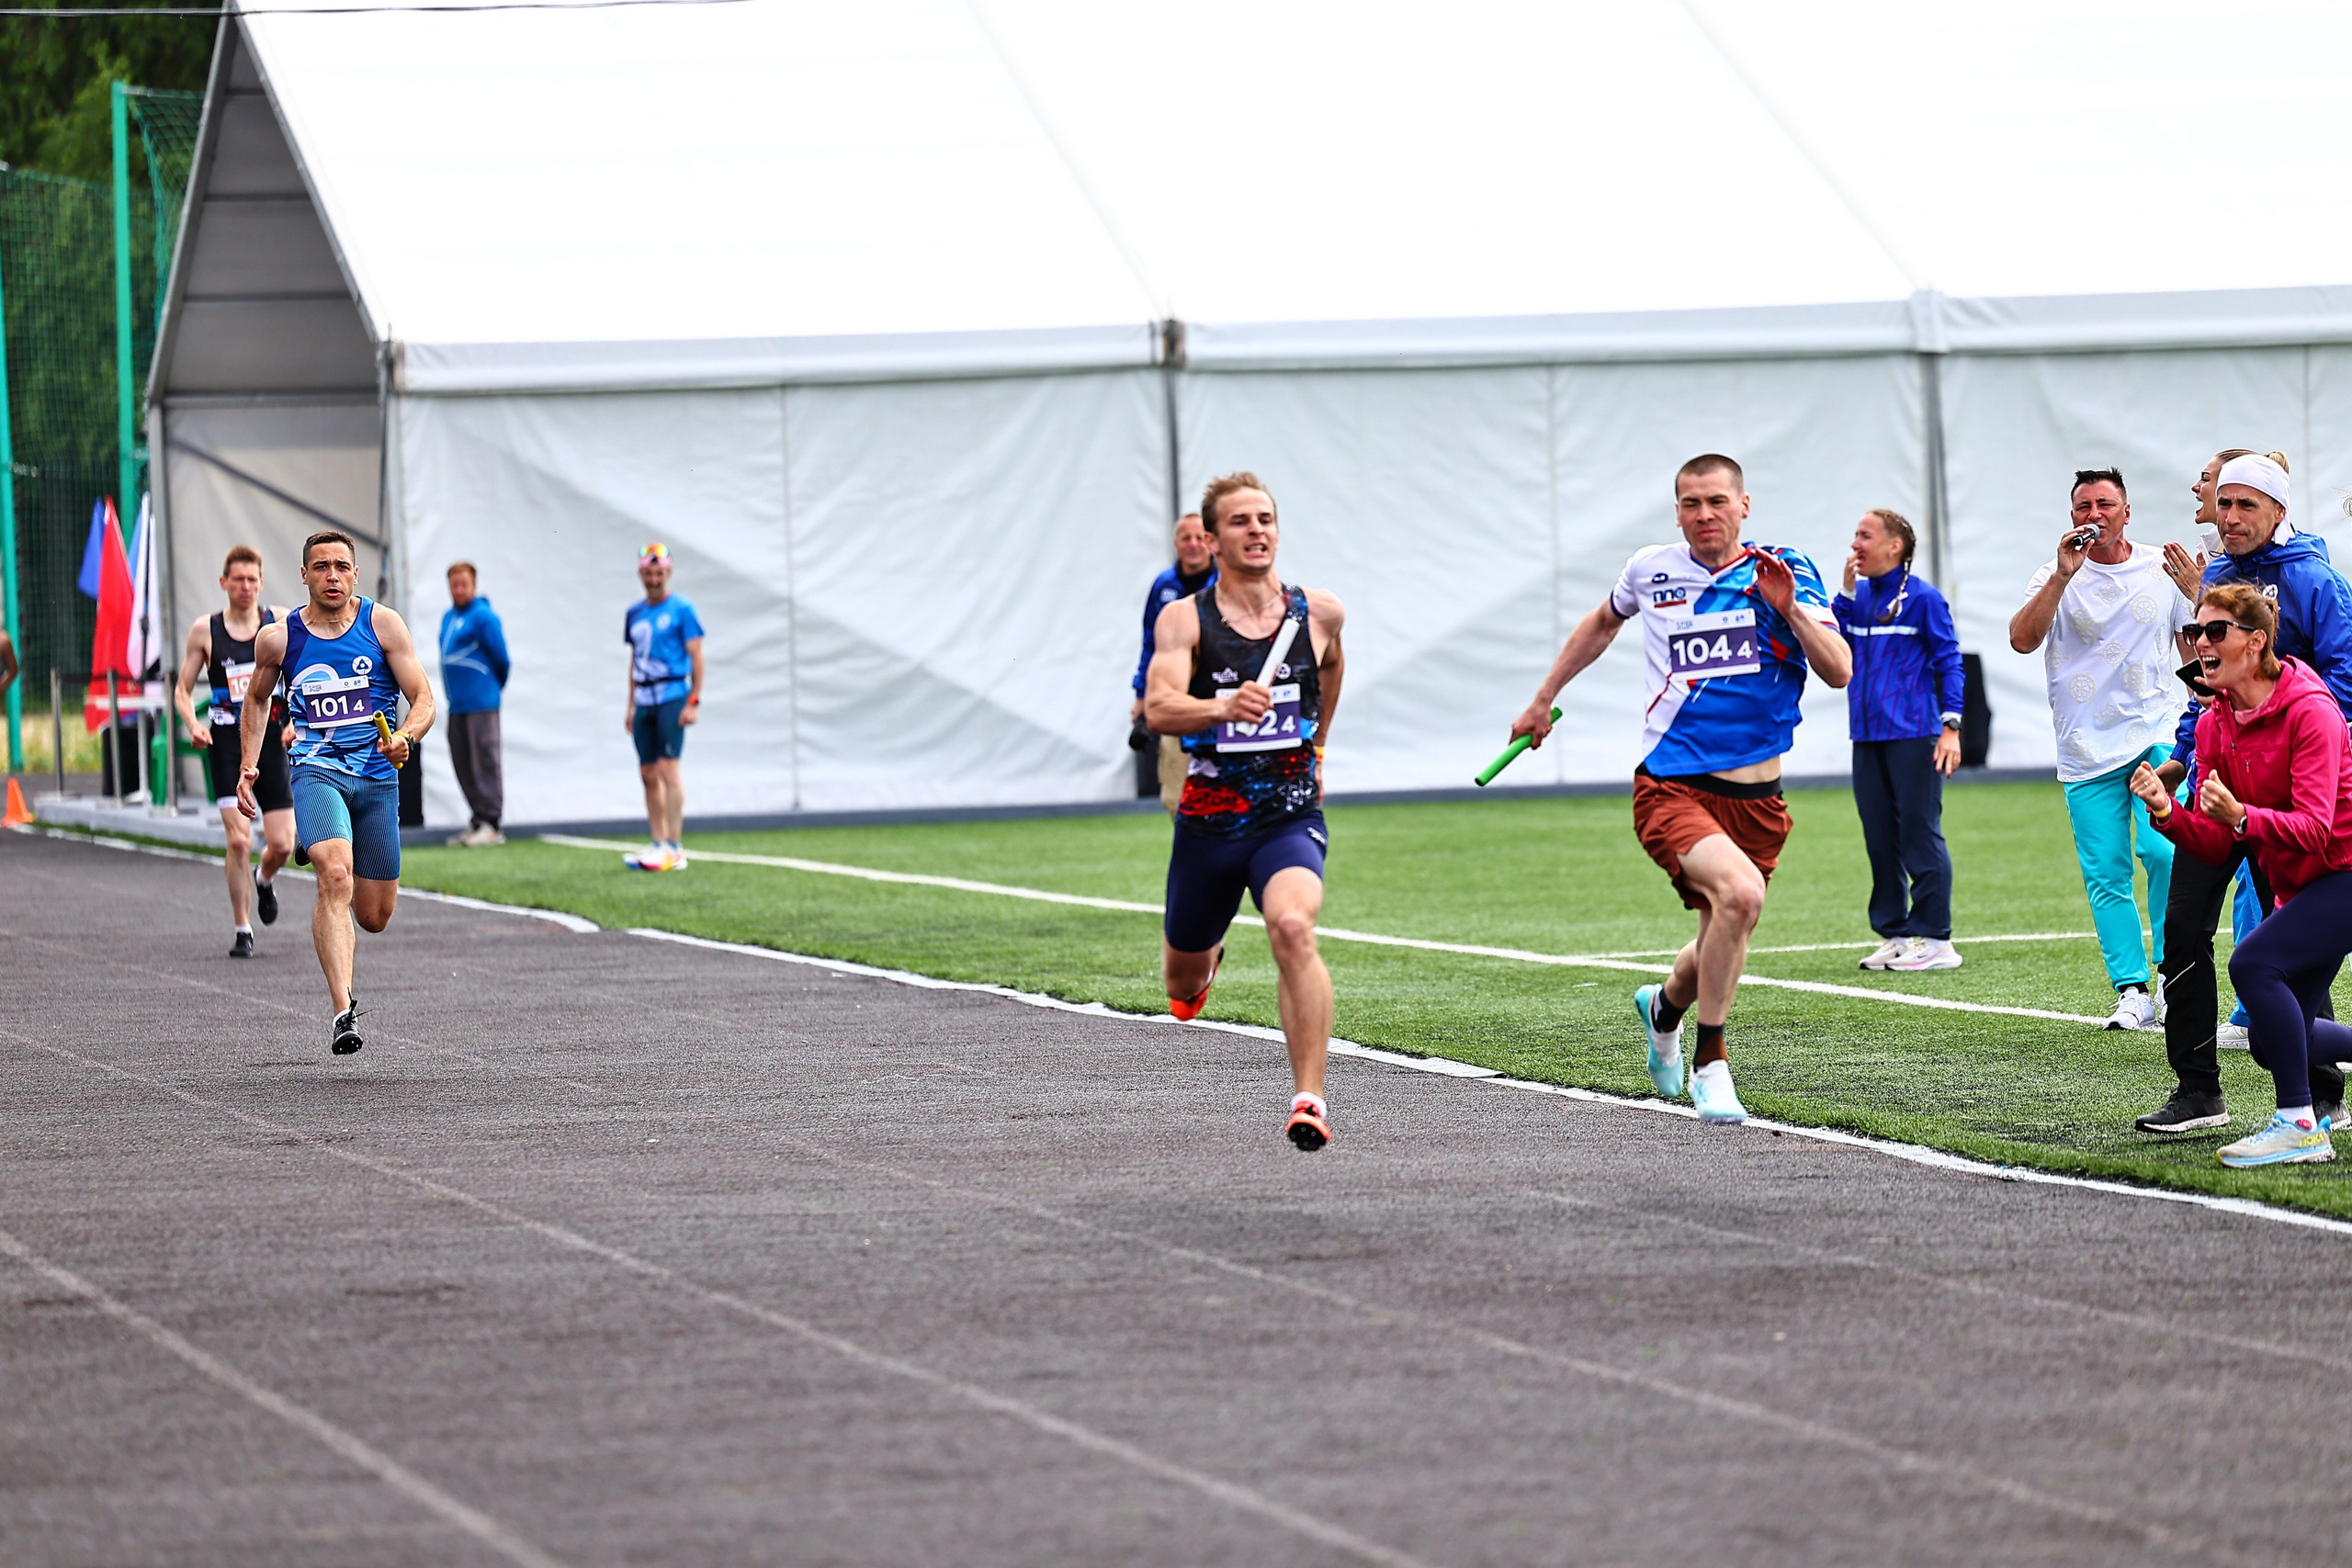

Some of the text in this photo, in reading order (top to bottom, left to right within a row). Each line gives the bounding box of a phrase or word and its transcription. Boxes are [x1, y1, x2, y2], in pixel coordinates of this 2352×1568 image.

[1672, 634, 1753, 666] 104 4
[310, 695, 366, 718] 101 4
[1281, 715, 1296, 733] 4
[2299, 1133, 2324, 1146] HOKA
